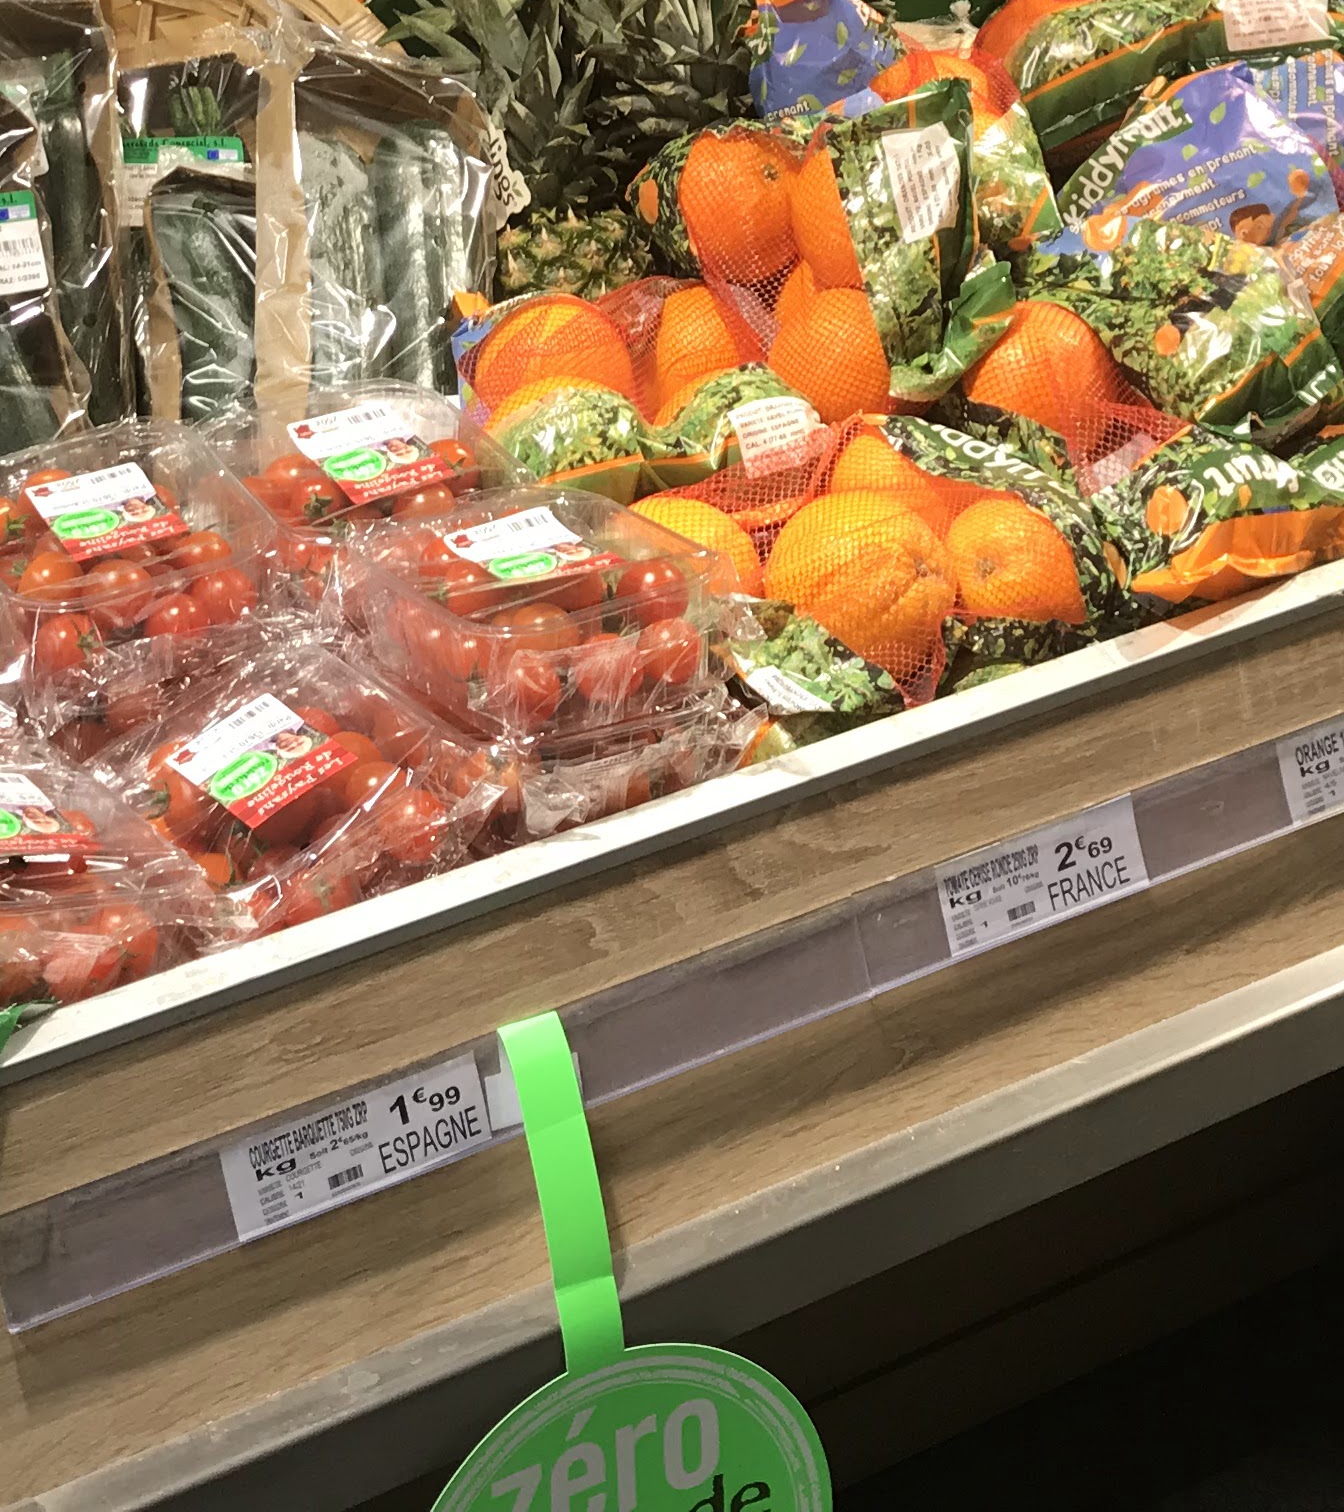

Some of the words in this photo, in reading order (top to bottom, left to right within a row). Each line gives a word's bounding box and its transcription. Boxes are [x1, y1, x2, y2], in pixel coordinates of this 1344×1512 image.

[1295, 733, 1340, 767] ORANGE
[1299, 759, 1331, 778] kg
[246, 760, 312, 808] Rougeline
[256, 772, 318, 816] Paysans
[1054, 834, 1113, 873] 2€69
[948, 890, 983, 909] kg
[1047, 855, 1132, 912] FRANCE
[389, 1086, 461, 1126] 1€99
[248, 1129, 296, 1170] COURGETTE
[294, 1112, 337, 1151] BARQUETTE
[354, 1100, 369, 1127] ZRP
[378, 1105, 483, 1174] ESPAGNE
[255, 1157, 297, 1182] kg
